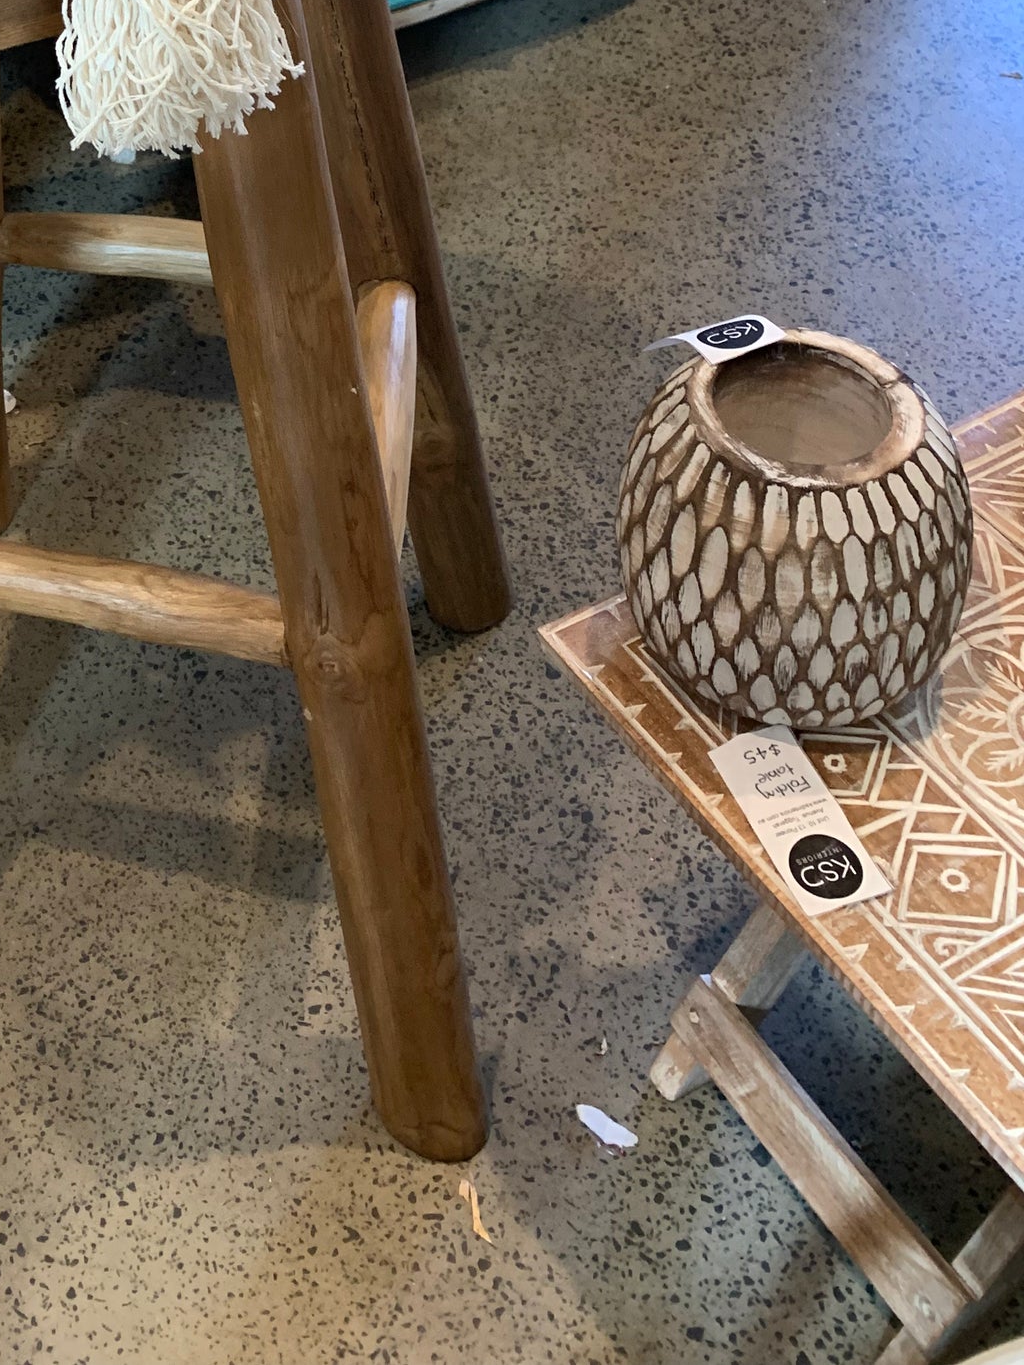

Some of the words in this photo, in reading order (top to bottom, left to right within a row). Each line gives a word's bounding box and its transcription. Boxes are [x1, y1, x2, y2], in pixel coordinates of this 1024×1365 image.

[743, 744, 781, 765] $45
[757, 763, 795, 783] table
[755, 776, 811, 799] Folding
[795, 846, 844, 866] INTERIORS
